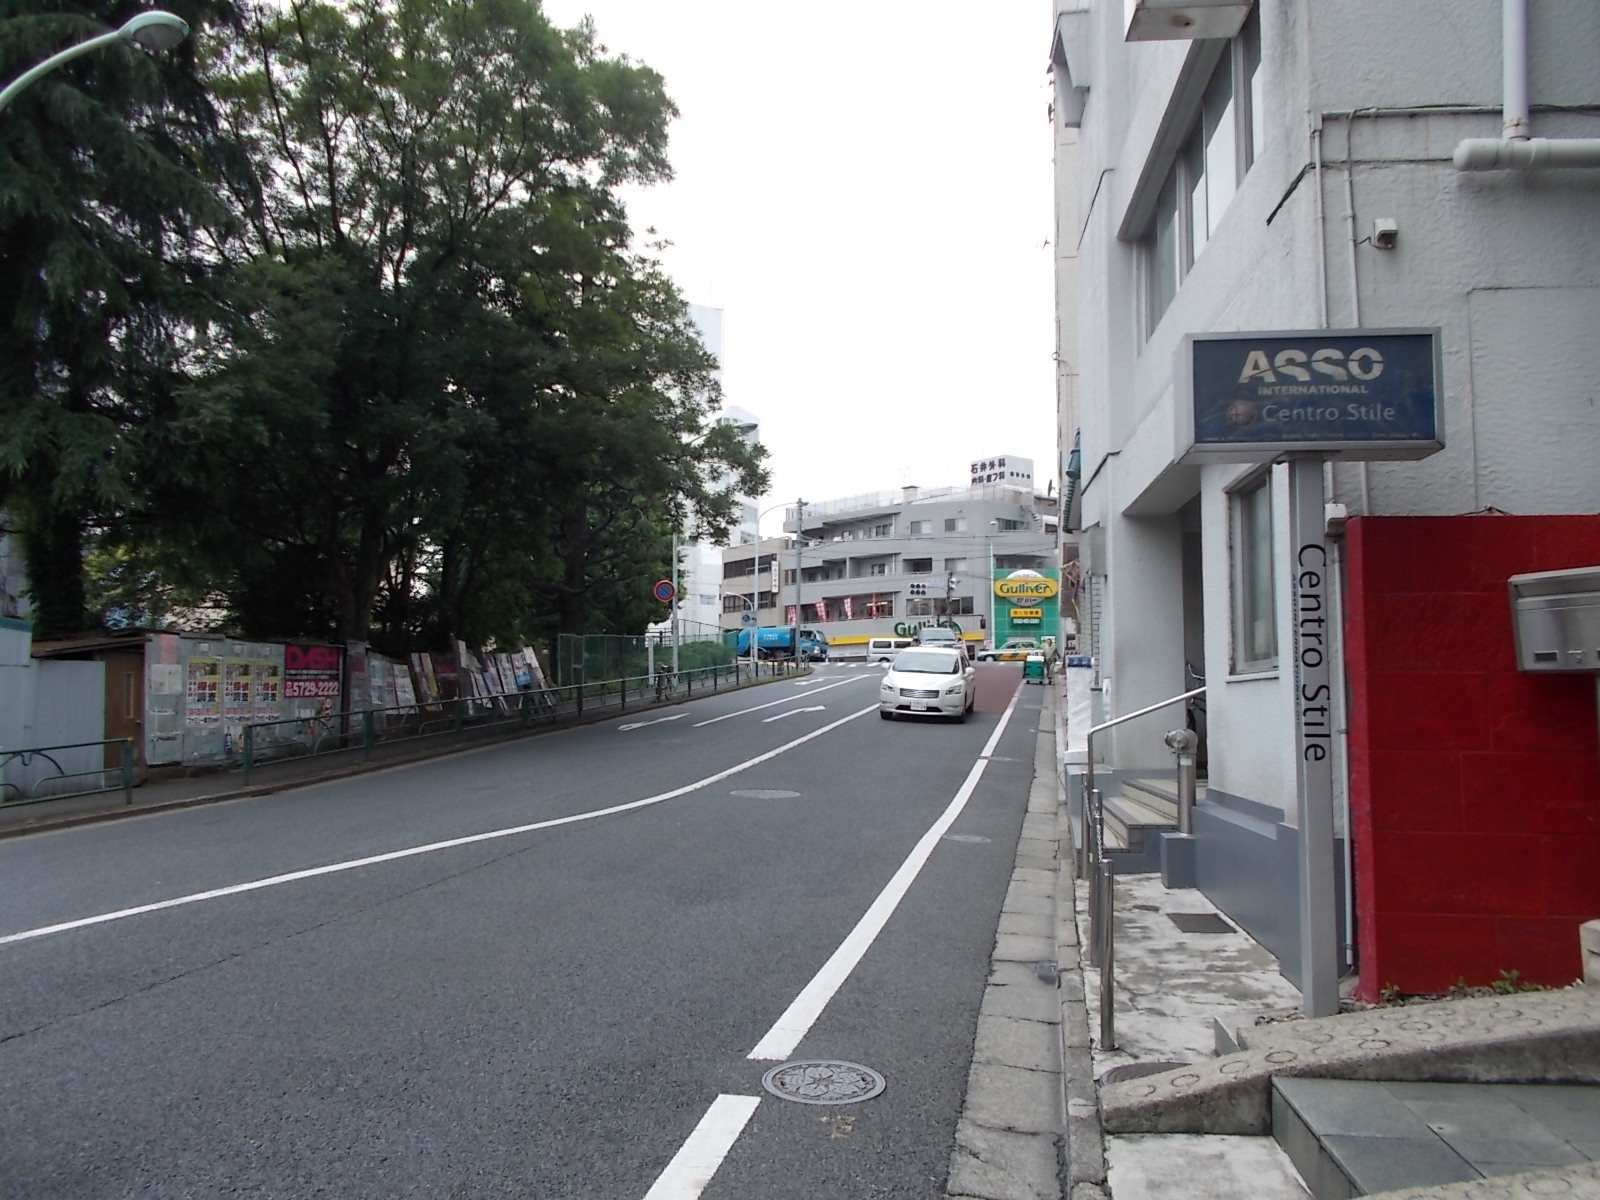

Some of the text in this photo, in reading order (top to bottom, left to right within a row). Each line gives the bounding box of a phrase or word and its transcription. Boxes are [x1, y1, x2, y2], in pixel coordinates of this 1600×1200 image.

[1238, 347, 1384, 384] ASSO
[1258, 385, 1369, 396] INTERNATIONAL
[1262, 403, 1396, 422] Centro Stile
[1000, 582, 1052, 594] Gulliver
[1298, 543, 1331, 762] Centro Stile
[293, 681, 339, 697] 5729-2222
